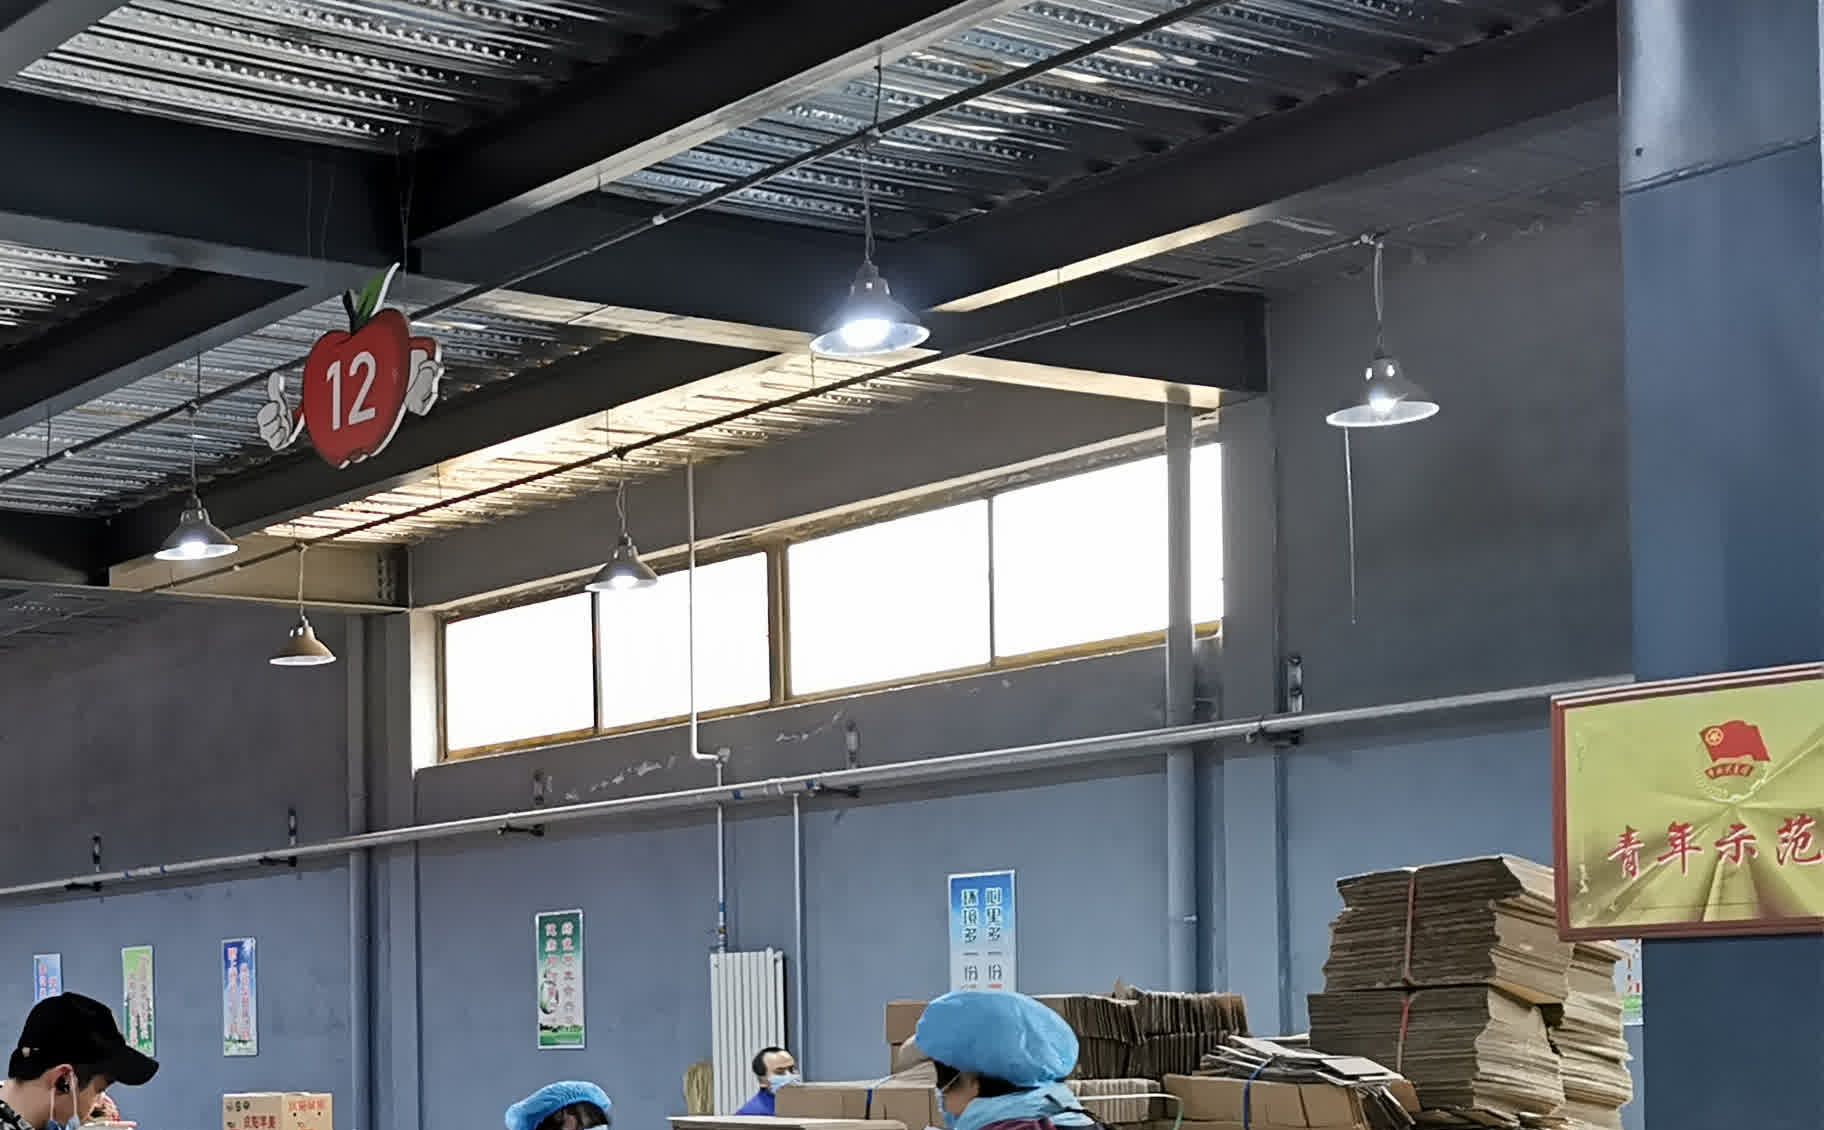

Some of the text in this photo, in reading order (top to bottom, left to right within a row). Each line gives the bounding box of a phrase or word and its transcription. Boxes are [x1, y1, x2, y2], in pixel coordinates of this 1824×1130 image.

[326, 351, 377, 432] 12
[1608, 813, 1824, 880] 青年示范
